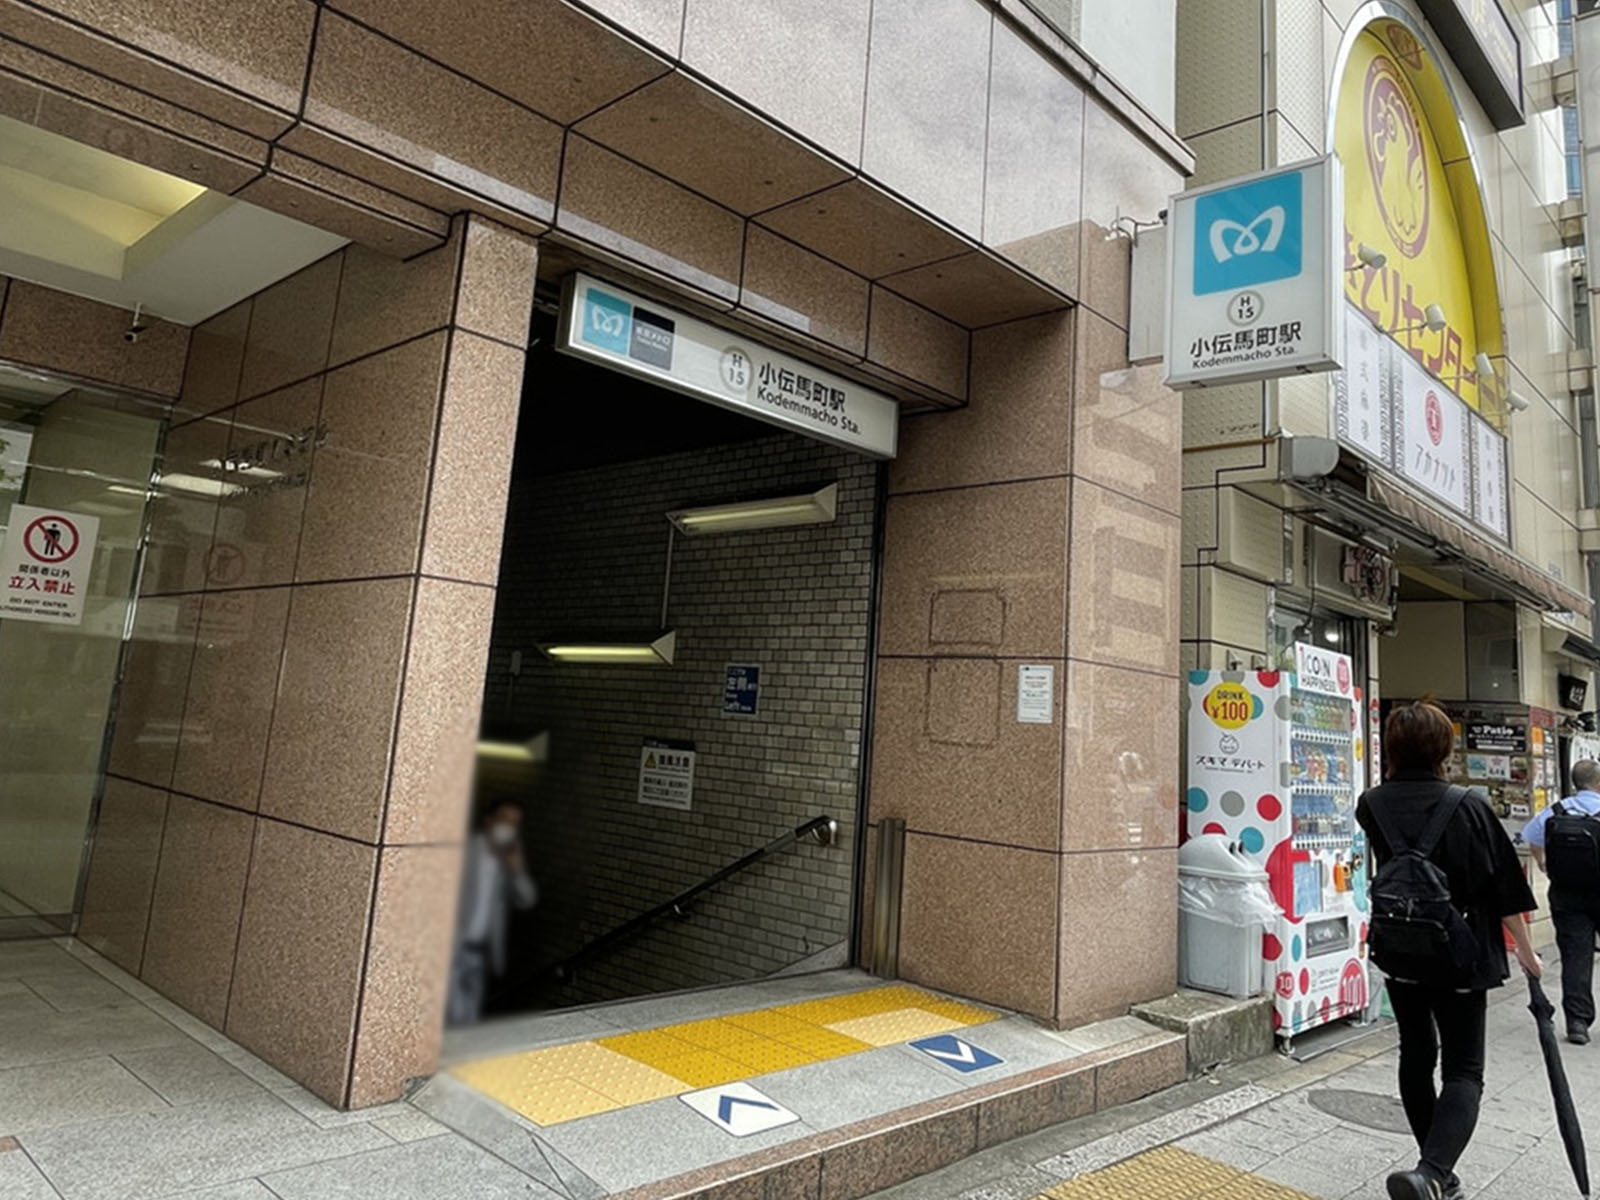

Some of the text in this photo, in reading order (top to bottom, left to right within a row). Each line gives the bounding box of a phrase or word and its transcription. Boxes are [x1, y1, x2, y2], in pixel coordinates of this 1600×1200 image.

[1240, 295, 1251, 307] H
[1237, 306, 1255, 320] 15
[1189, 321, 1302, 358] 小伝馬町駅
[731, 353, 743, 368] H
[1193, 345, 1298, 369] Kodemmacho Sta.
[729, 367, 745, 386] 15
[758, 362, 846, 413] 小伝馬町駅
[757, 385, 861, 435] Kodemmacho Sta.
[8, 575, 76, 596] 立入禁止
[1217, 690, 1243, 701] DRINK
